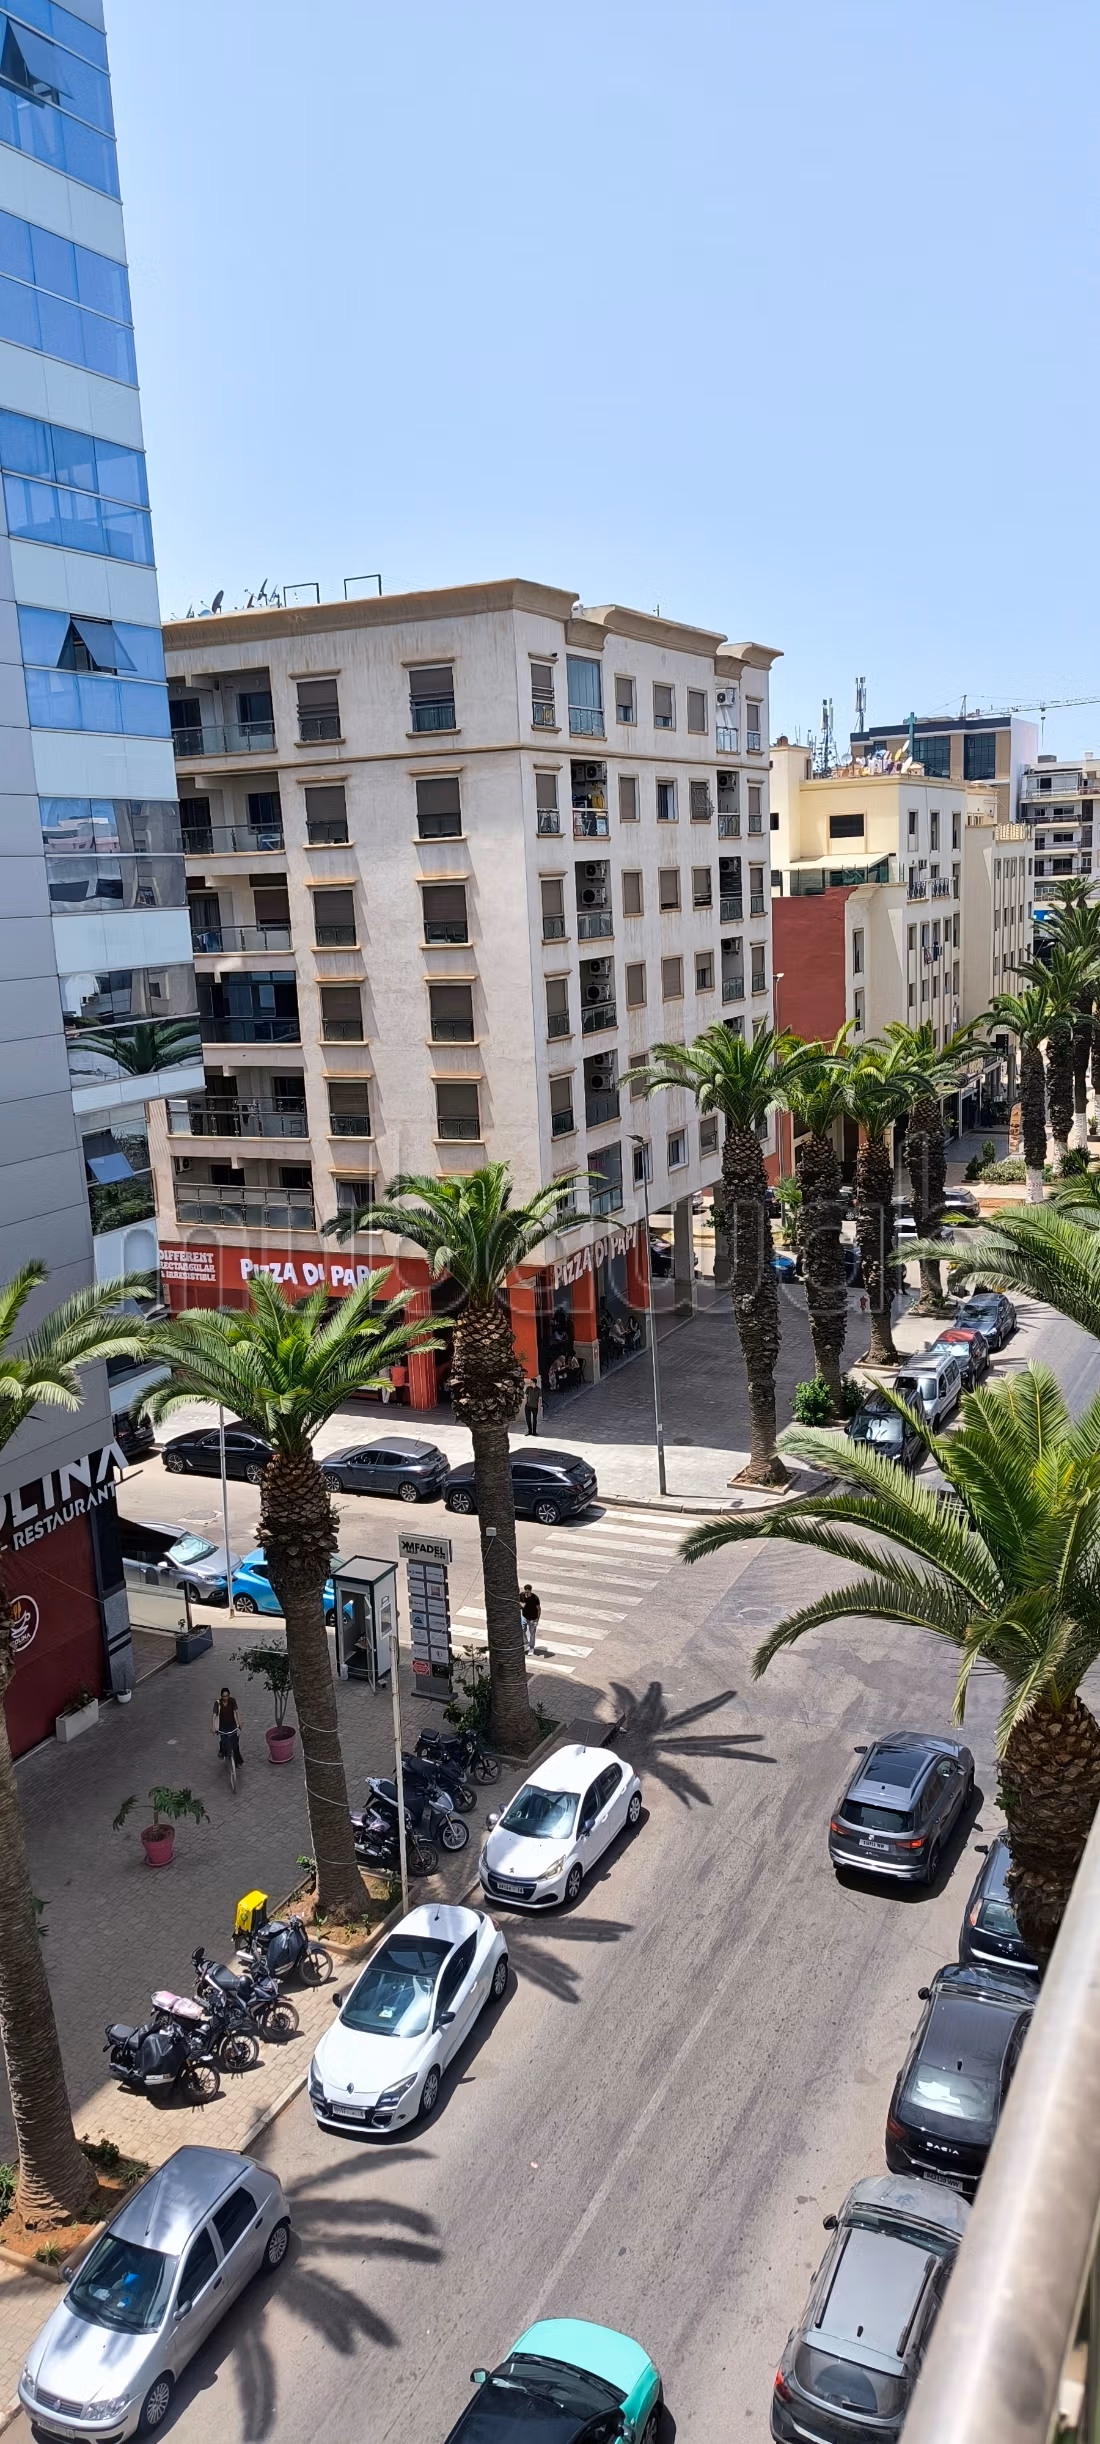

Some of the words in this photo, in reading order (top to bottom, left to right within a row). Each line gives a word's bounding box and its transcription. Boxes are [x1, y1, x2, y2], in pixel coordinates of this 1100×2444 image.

[303, 1263, 324, 1285] DI
[554, 1247, 592, 1290] PIZZA
[595, 1237, 607, 1268] DI
[611, 1226, 636, 1259] PAPI
[0, 1438, 130, 1531] LINA
[13, 1480, 117, 1551] RESTAURANT
